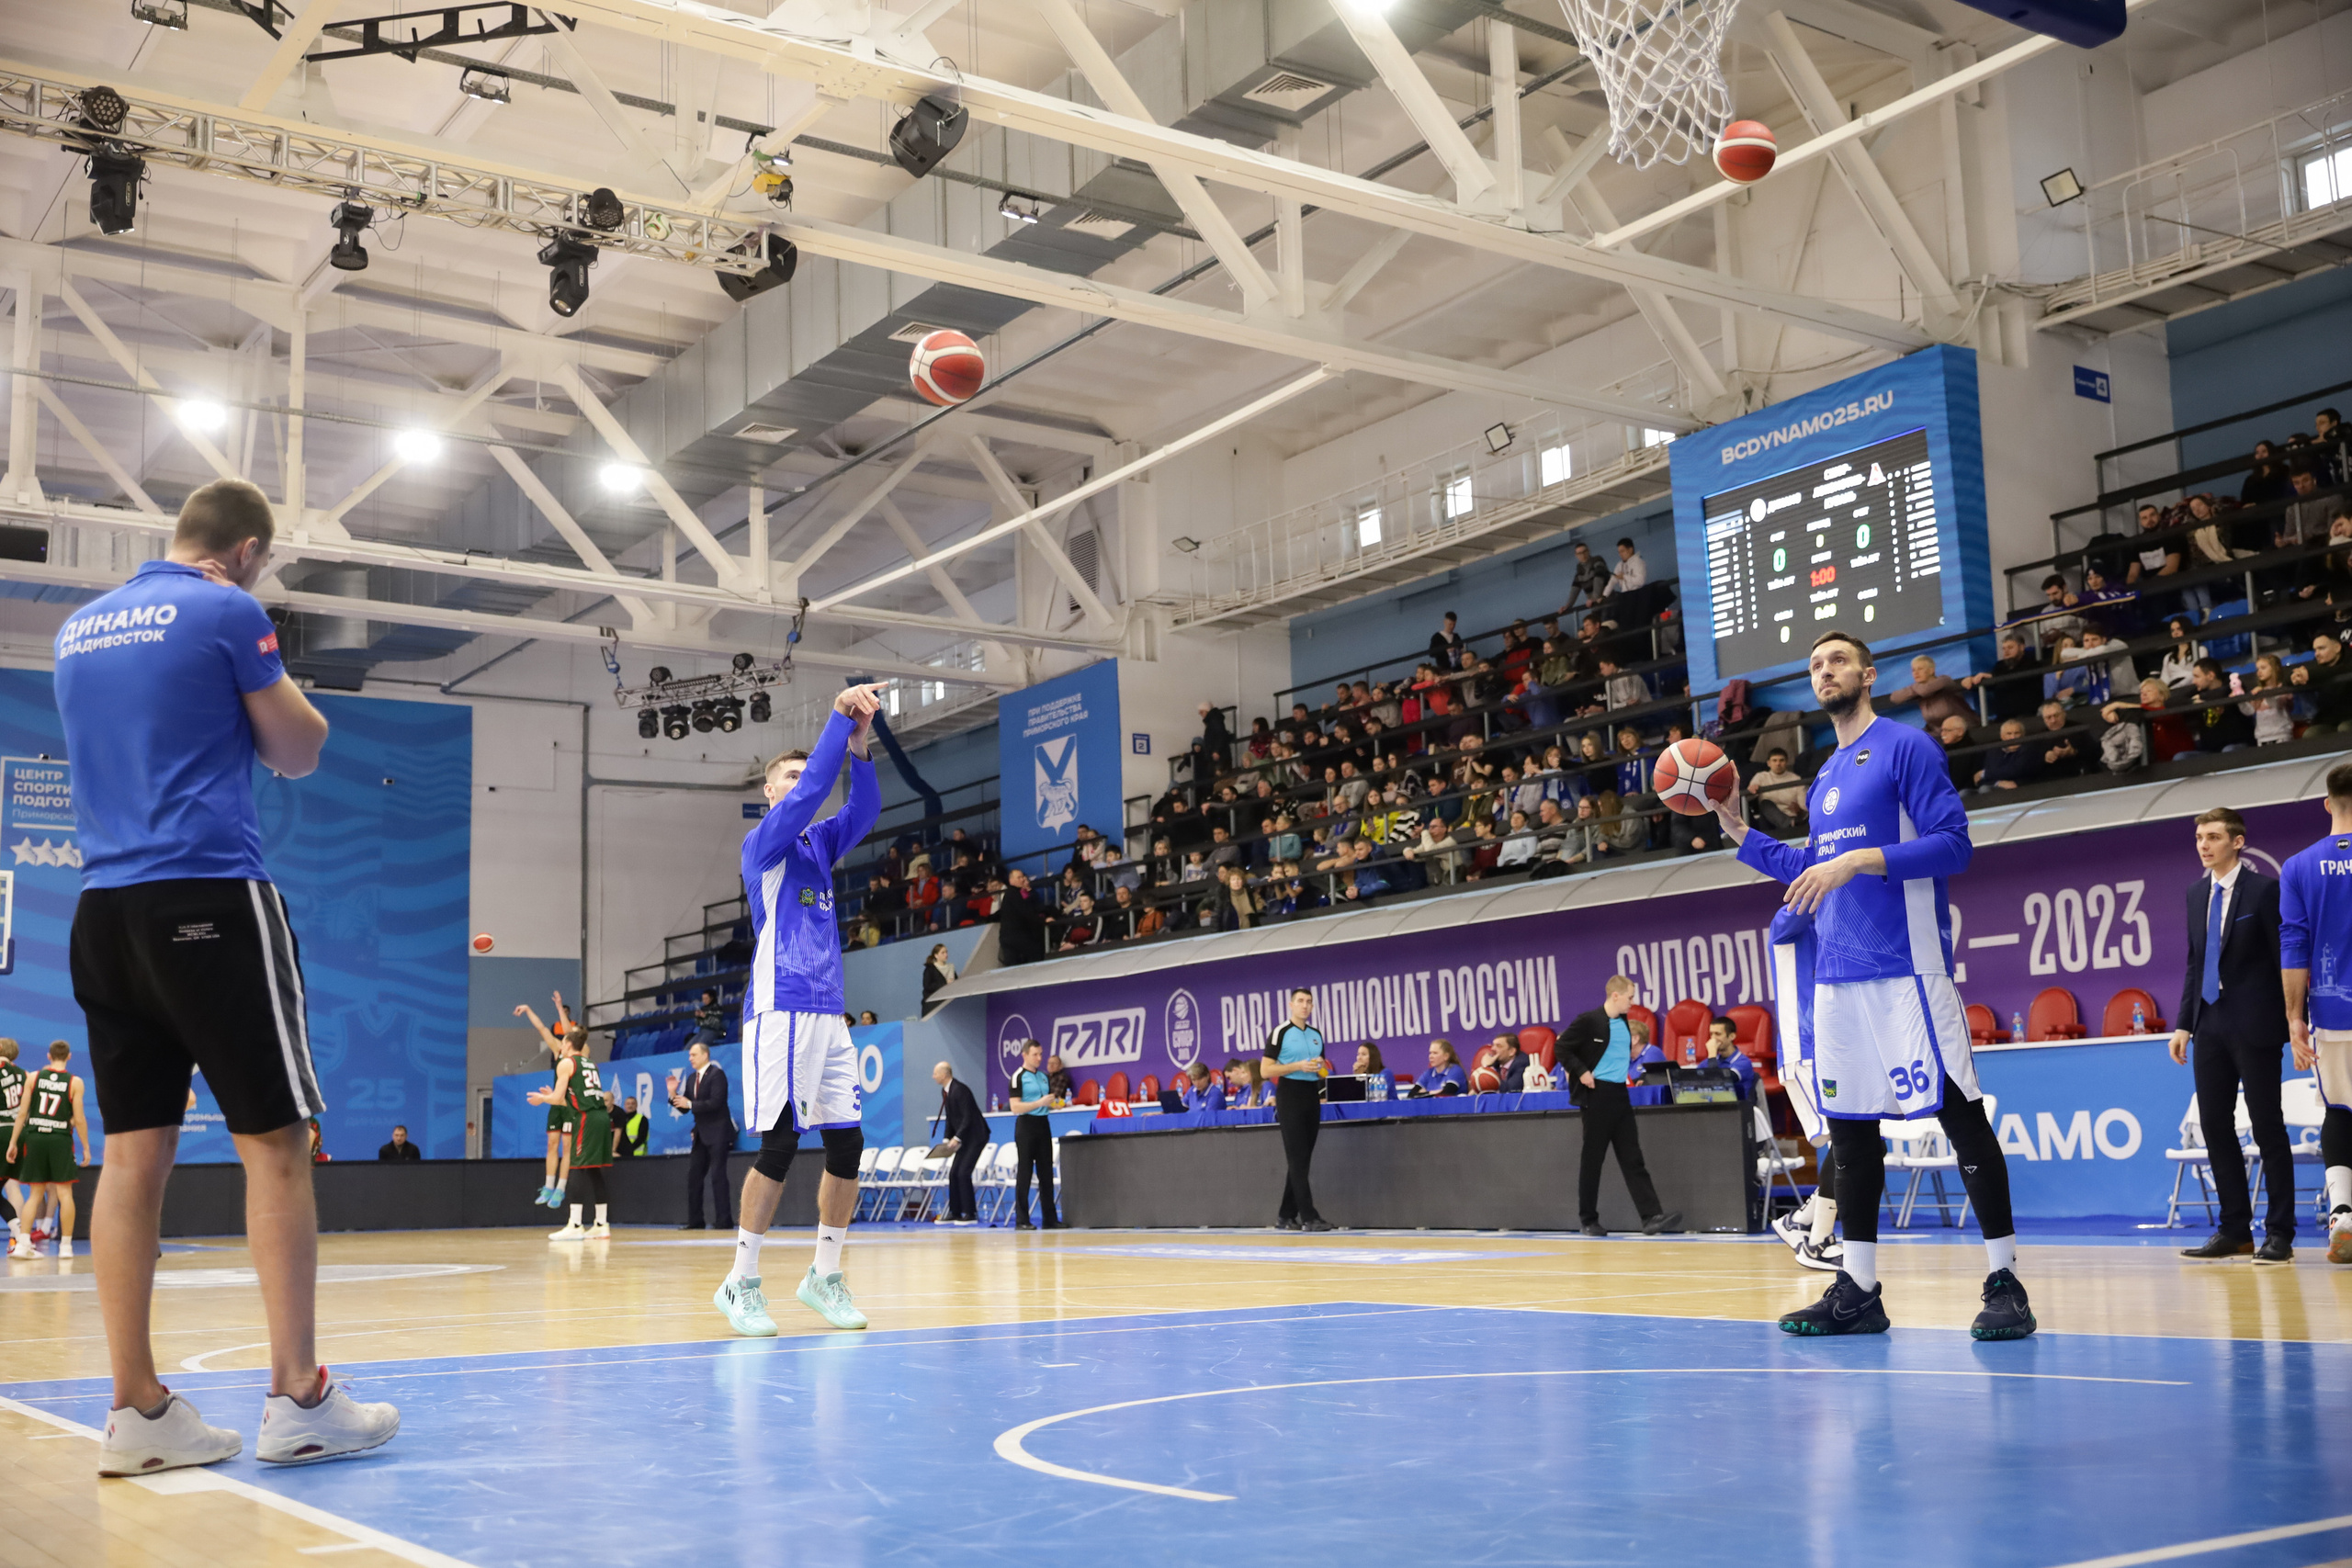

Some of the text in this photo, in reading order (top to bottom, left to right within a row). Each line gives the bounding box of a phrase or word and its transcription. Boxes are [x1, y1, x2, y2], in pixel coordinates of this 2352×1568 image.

[1722, 390, 1894, 465] BCDYNAMO25.RU
[1856, 524, 1871, 549] 0
[1773, 547, 1786, 572] 0
[1810, 565, 1836, 587] 1:00
[60, 604, 178, 648] ДИНАМО
[60, 630, 166, 660] ВЛАДИВОСТОК
[14, 768, 64, 781] ЦЕНТР
[13, 781, 72, 795] СПОРТИ
[12, 794, 72, 808] ПОДГОТ
[12, 807, 76, 821] Приморско
[1818, 824, 1867, 845] ПРИМОРСКИЙ
[1817, 842, 1836, 857] КРАЙ
[1220, 955, 1561, 1053] PARI ЧМПИОНАТ РОССИИ
[1057, 1014, 1140, 1060] PARI
[582, 1069, 602, 1089] 24
[1889, 1060, 1929, 1100] 36
[39, 1091, 62, 1117] 17
[345, 1077, 407, 1110] 25
[1996, 1108, 2143, 1161] AMO
